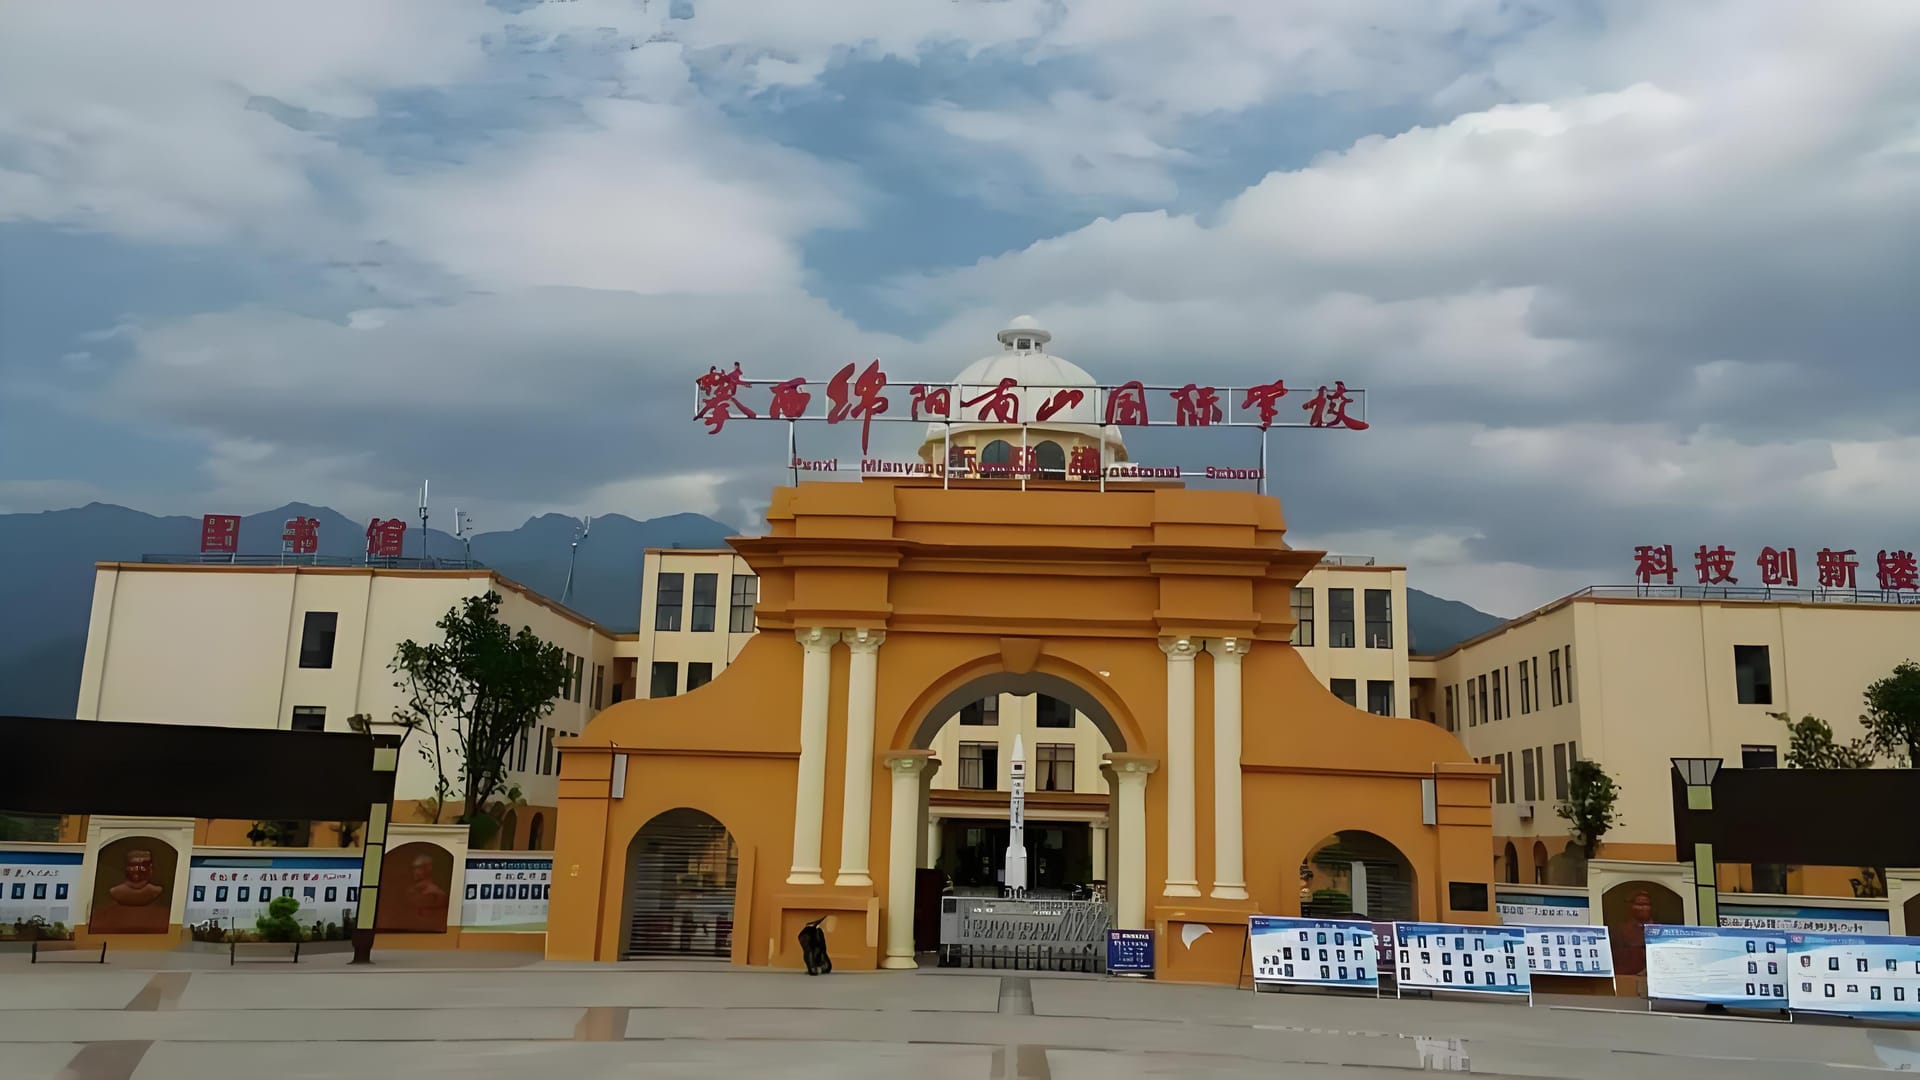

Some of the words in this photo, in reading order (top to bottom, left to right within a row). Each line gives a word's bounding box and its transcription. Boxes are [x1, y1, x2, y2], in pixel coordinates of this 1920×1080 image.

[1634, 544, 1920, 591] 科技创新楼
